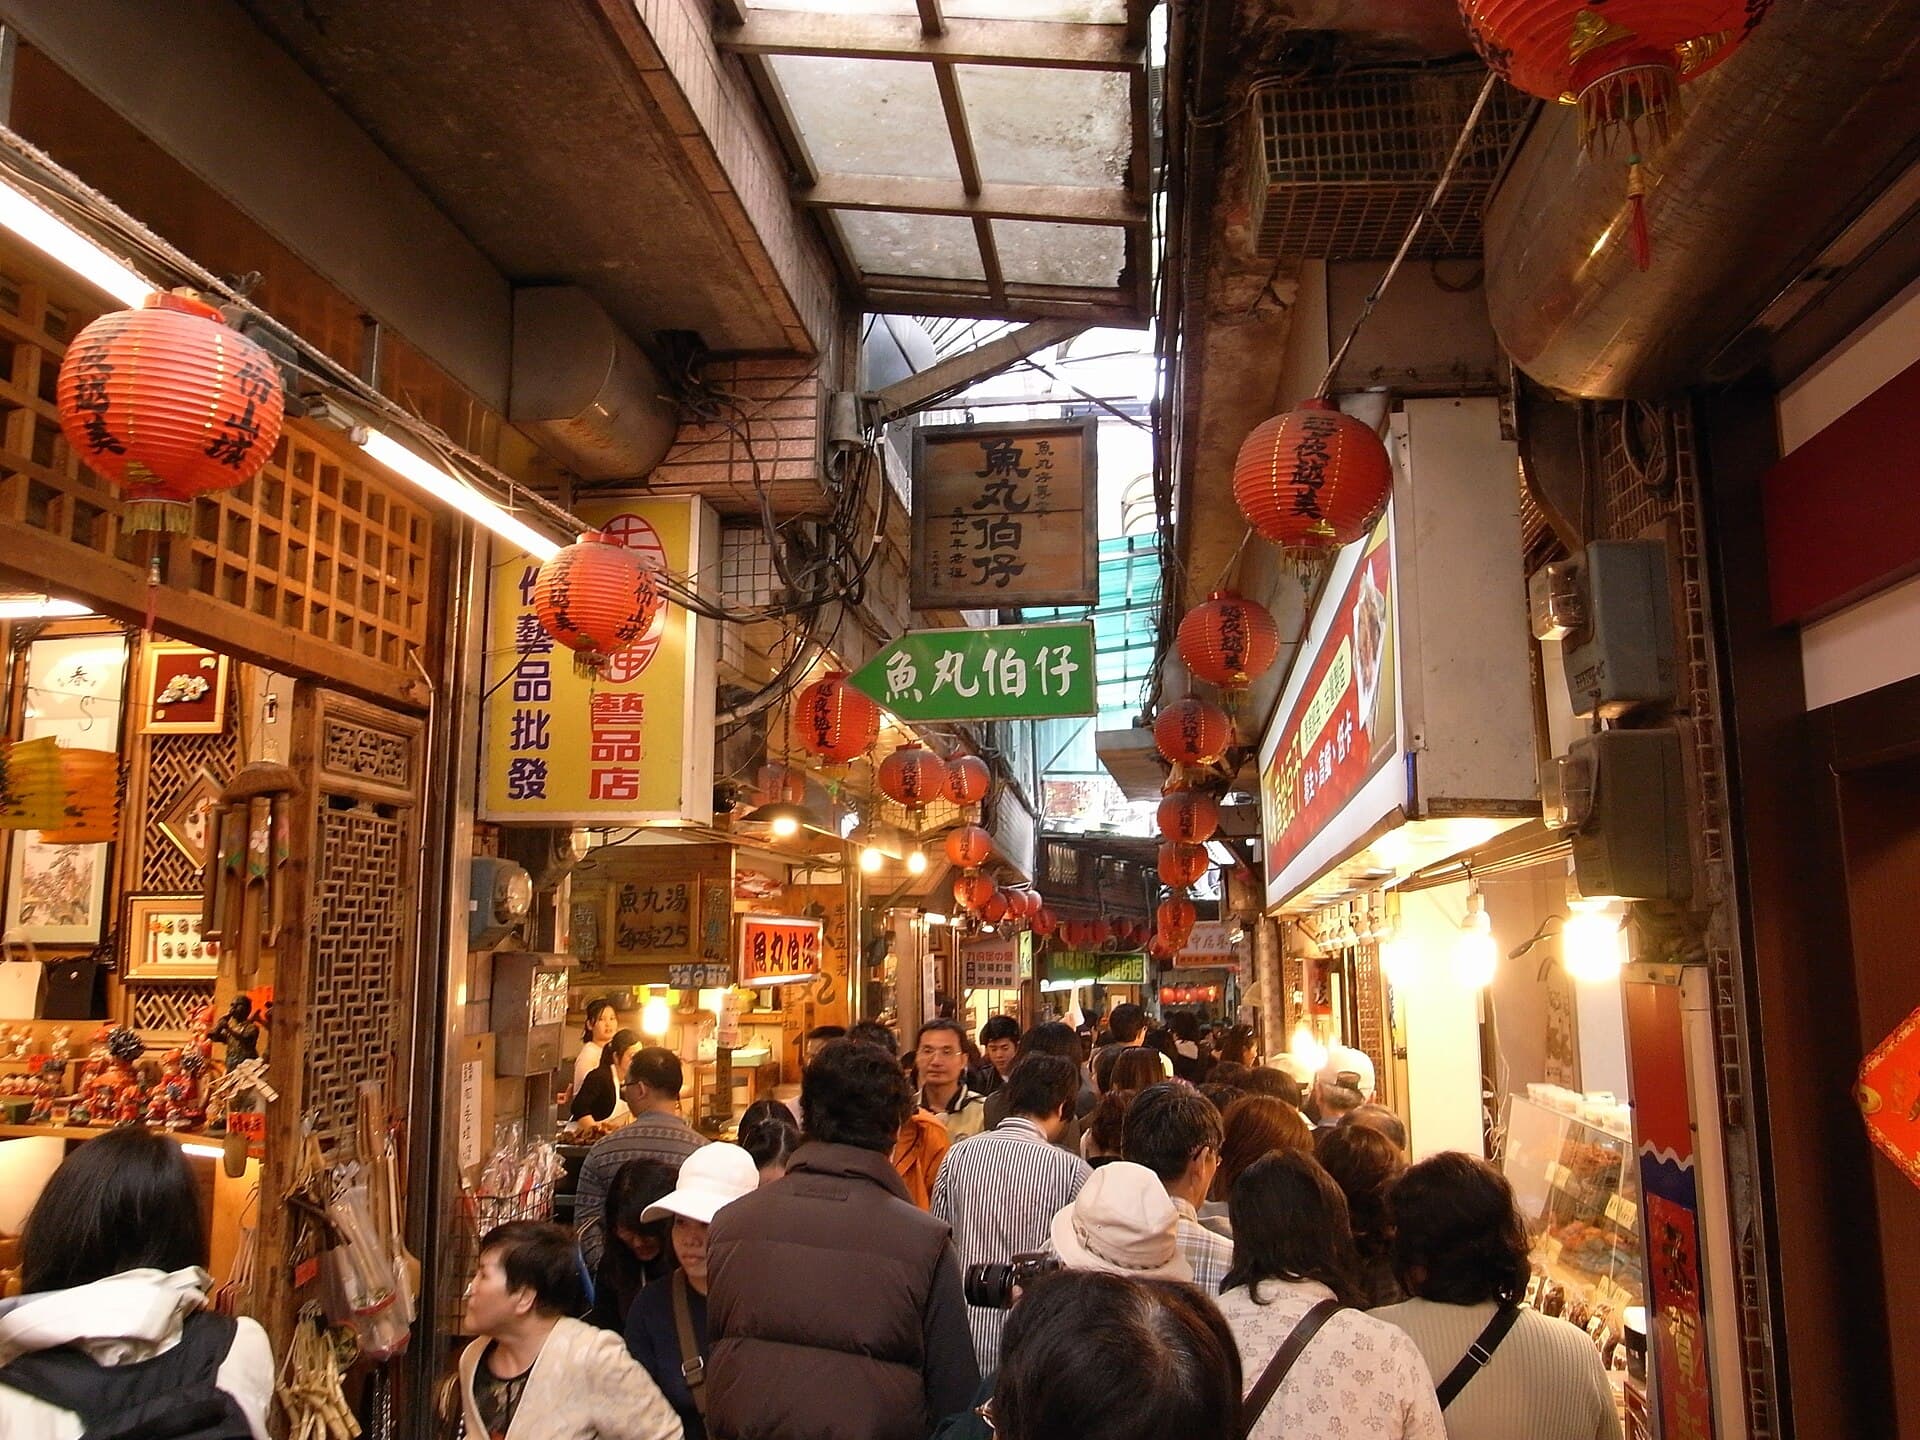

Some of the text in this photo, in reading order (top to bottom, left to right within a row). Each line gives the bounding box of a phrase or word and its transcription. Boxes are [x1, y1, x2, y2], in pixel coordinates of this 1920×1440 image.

[971, 438, 1032, 588] 魚丸伯仔
[886, 646, 1078, 703] 魚丸伯仔
[589, 693, 644, 800] 藝品店
[617, 884, 688, 914] 魚丸湯
